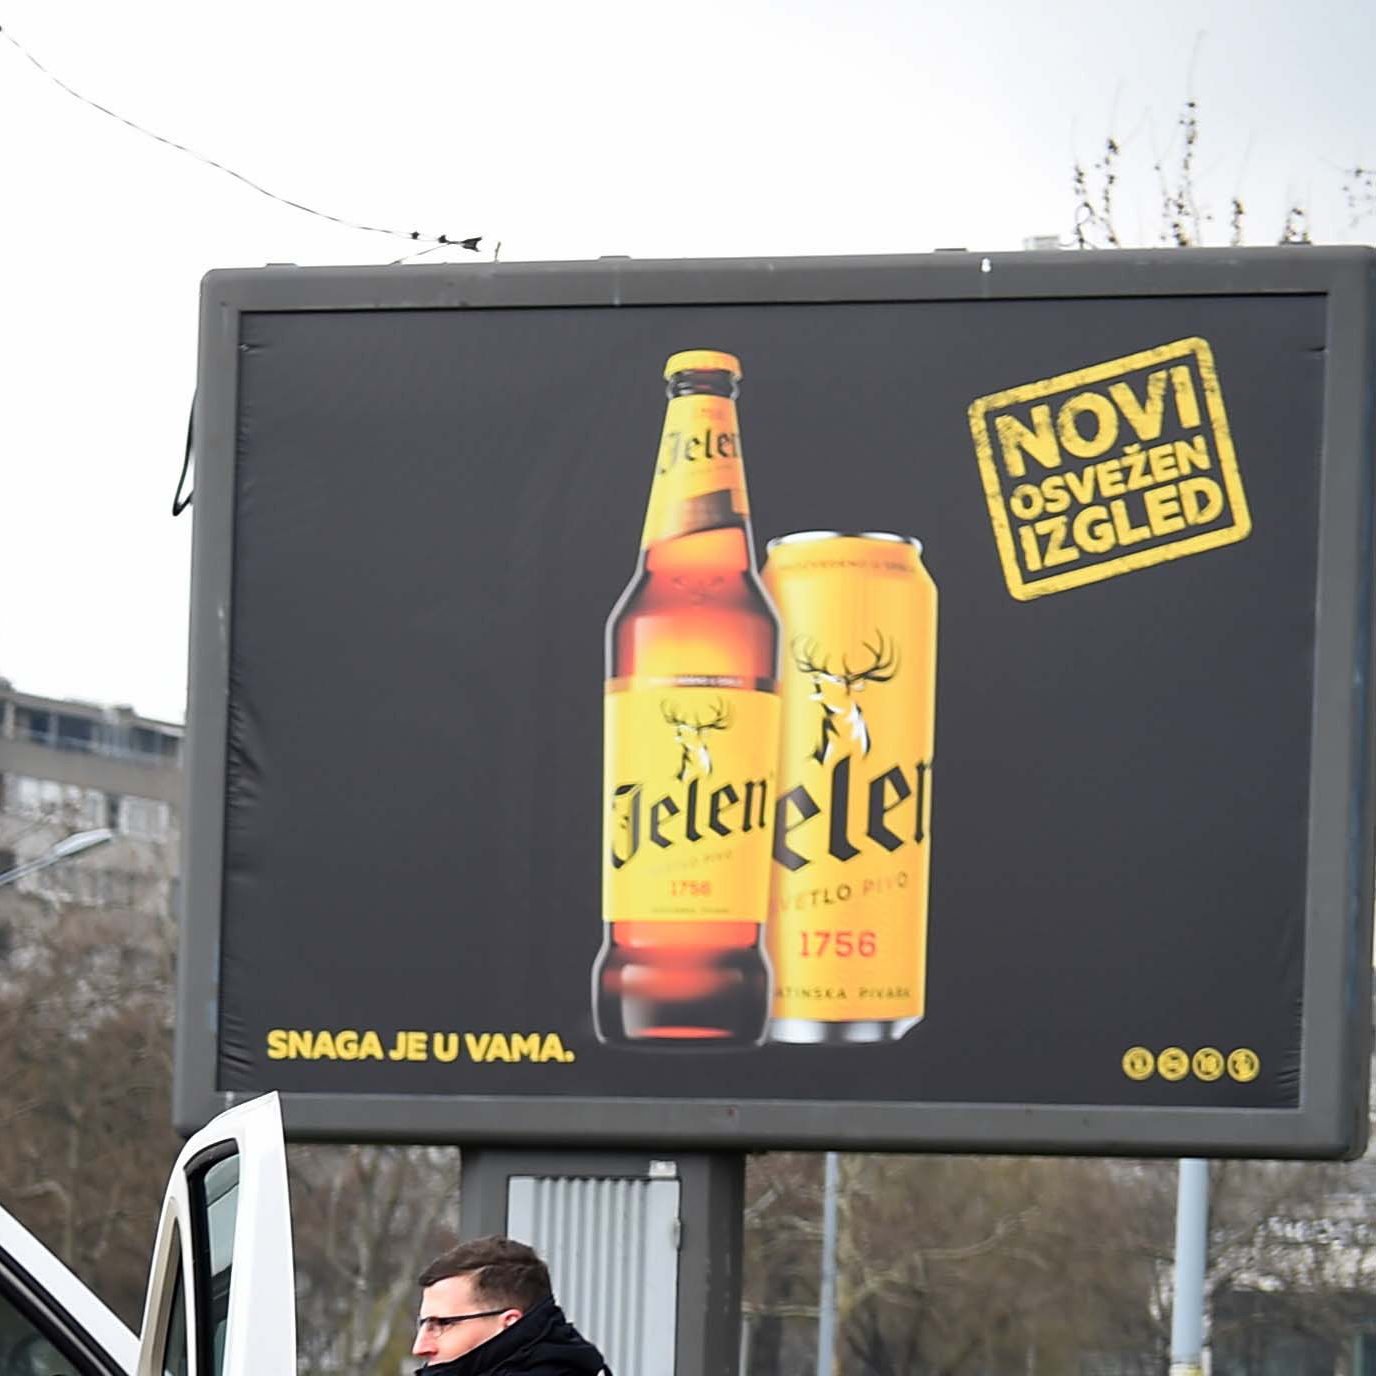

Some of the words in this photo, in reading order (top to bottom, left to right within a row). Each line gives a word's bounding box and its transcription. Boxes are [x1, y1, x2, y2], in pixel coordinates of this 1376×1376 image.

[995, 364, 1202, 478] NOVI
[1009, 434, 1212, 521] OSVEŽEN
[1018, 476, 1225, 572] IZGLED
[611, 778, 768, 870] Jelen
[799, 928, 878, 959] 1756
[267, 1030, 384, 1061] SNAGA
[388, 1031, 428, 1061] JE
[433, 1032, 459, 1062] U
[464, 1032, 576, 1063] VAMA.
